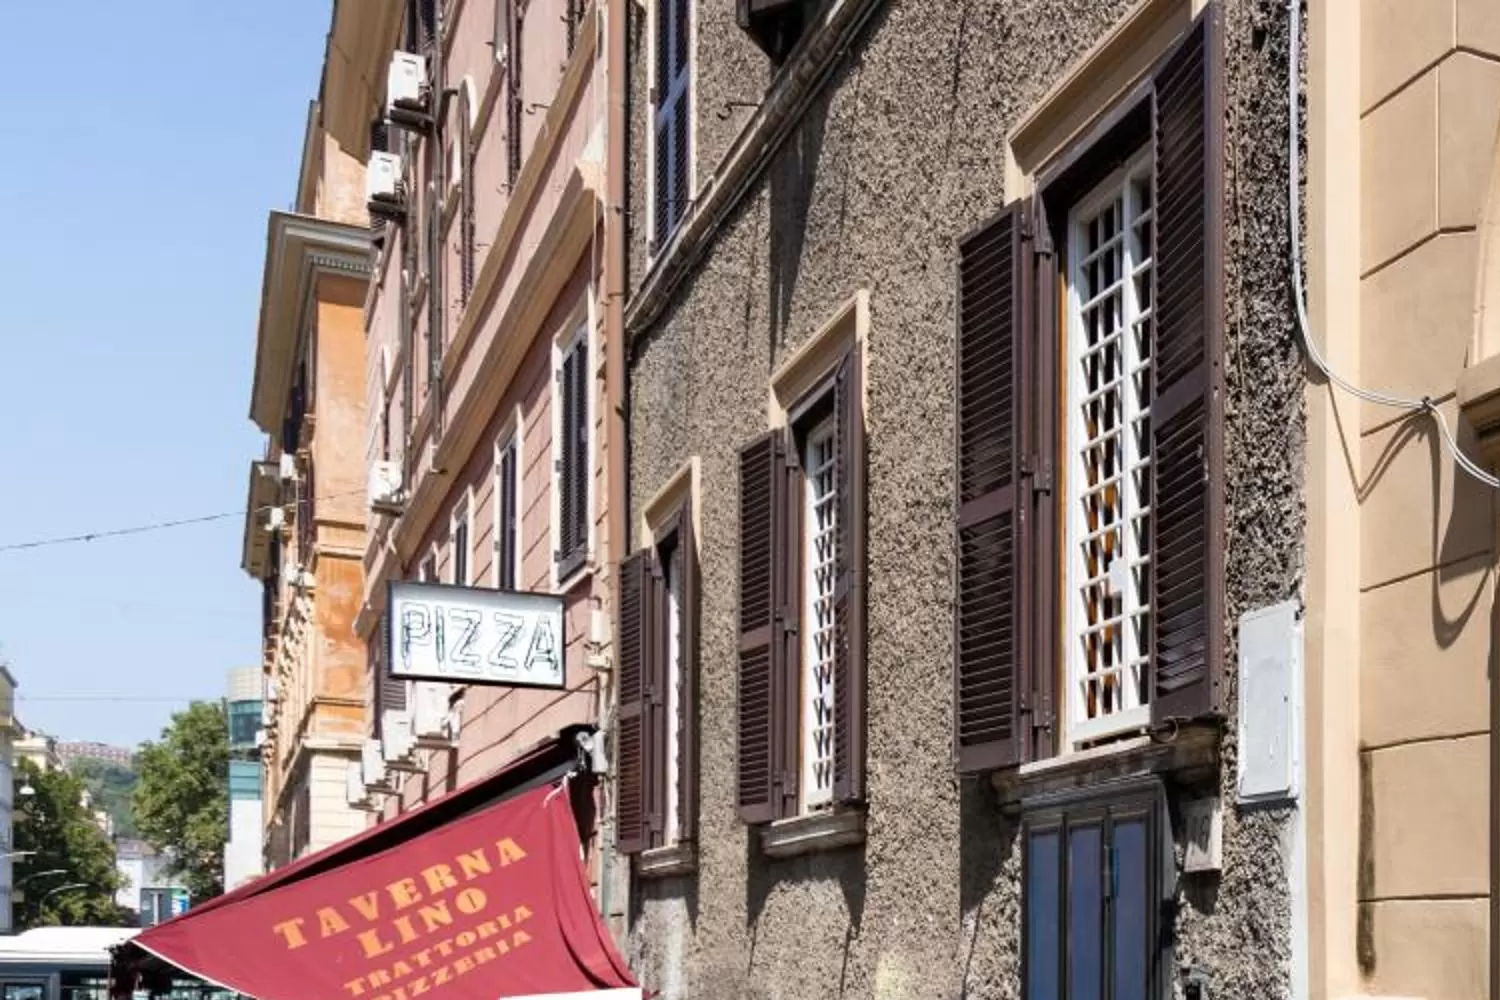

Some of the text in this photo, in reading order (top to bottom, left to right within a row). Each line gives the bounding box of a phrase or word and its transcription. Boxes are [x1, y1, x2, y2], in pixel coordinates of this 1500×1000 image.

[401, 602, 560, 678] PIZZA
[273, 837, 528, 950] TAVERNA
[356, 887, 488, 960] LINO
[343, 904, 534, 997] TRATTORIA
